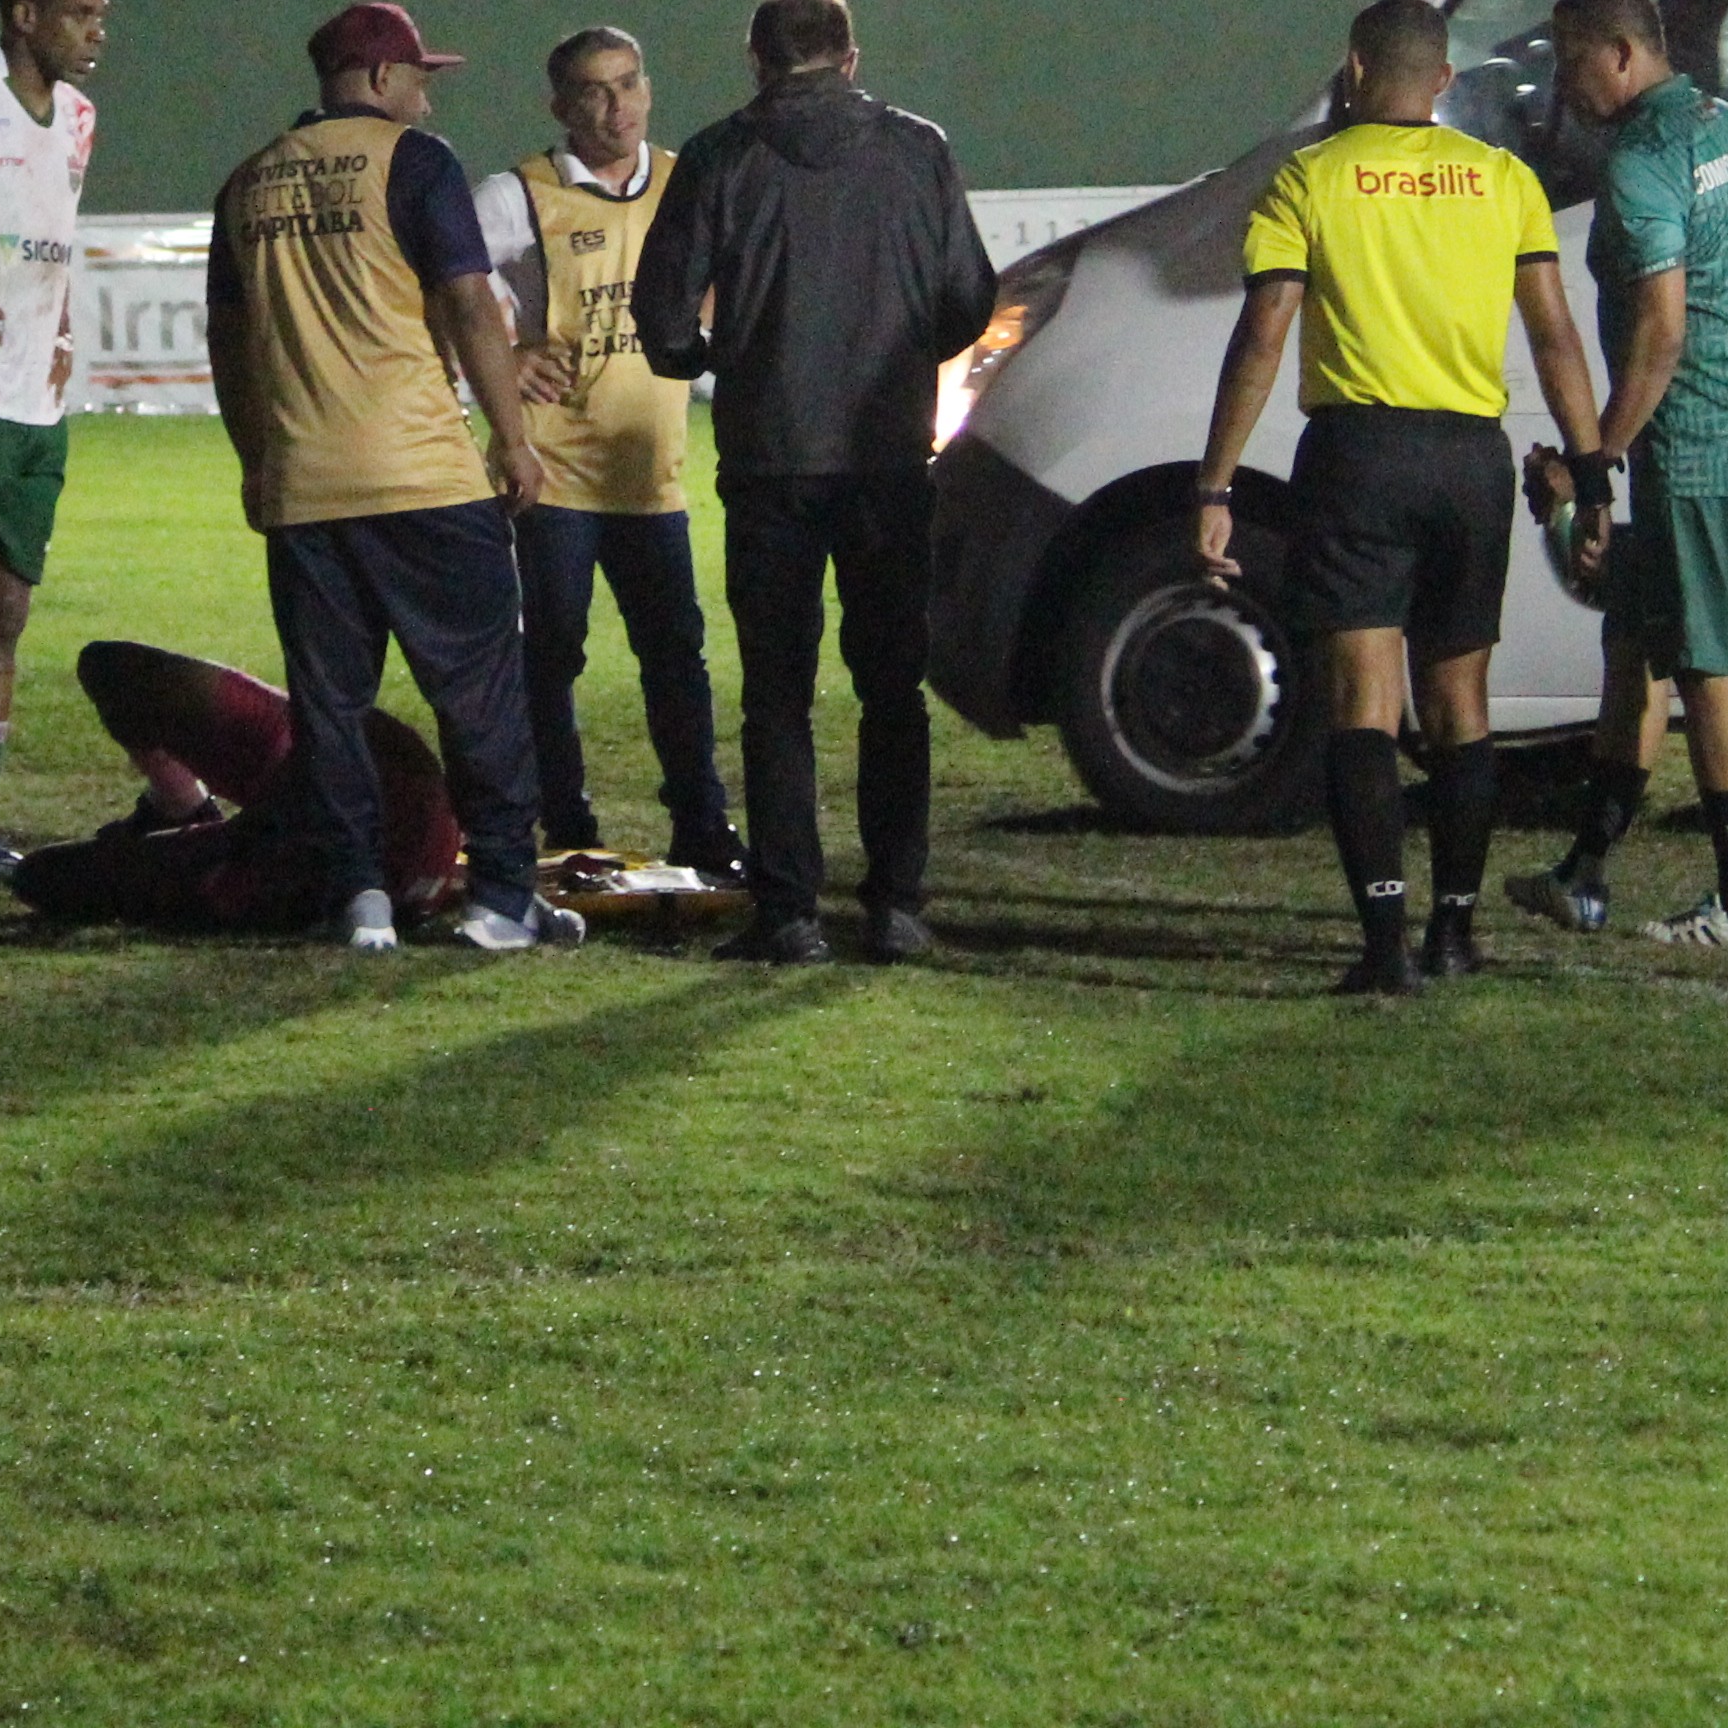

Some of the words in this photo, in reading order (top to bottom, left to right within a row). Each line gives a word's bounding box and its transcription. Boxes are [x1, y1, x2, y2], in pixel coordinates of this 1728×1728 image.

[333, 154, 369, 173] NO
[1355, 164, 1484, 198] brasilit
[587, 332, 640, 356] CAPI
